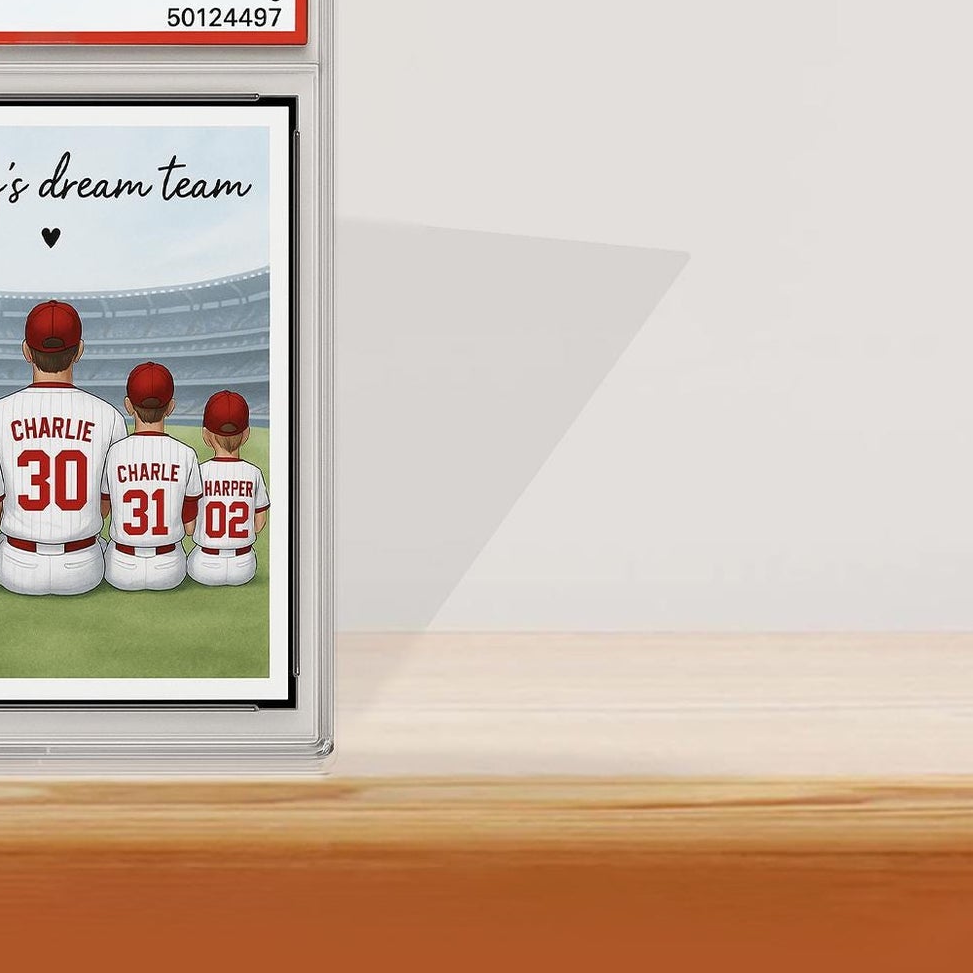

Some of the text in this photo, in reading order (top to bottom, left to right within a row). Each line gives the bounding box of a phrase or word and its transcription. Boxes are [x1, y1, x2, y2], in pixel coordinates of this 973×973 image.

[168, 8, 281, 26] 50124497
[39, 152, 152, 199] dream
[158, 155, 252, 200] team
[11, 417, 95, 443] CHARLIE
[18, 450, 87, 511] 30
[117, 463, 180, 483] CHARLE
[204, 480, 254, 498] HARPER
[123, 489, 168, 535] 31
[206, 502, 249, 537] 02
